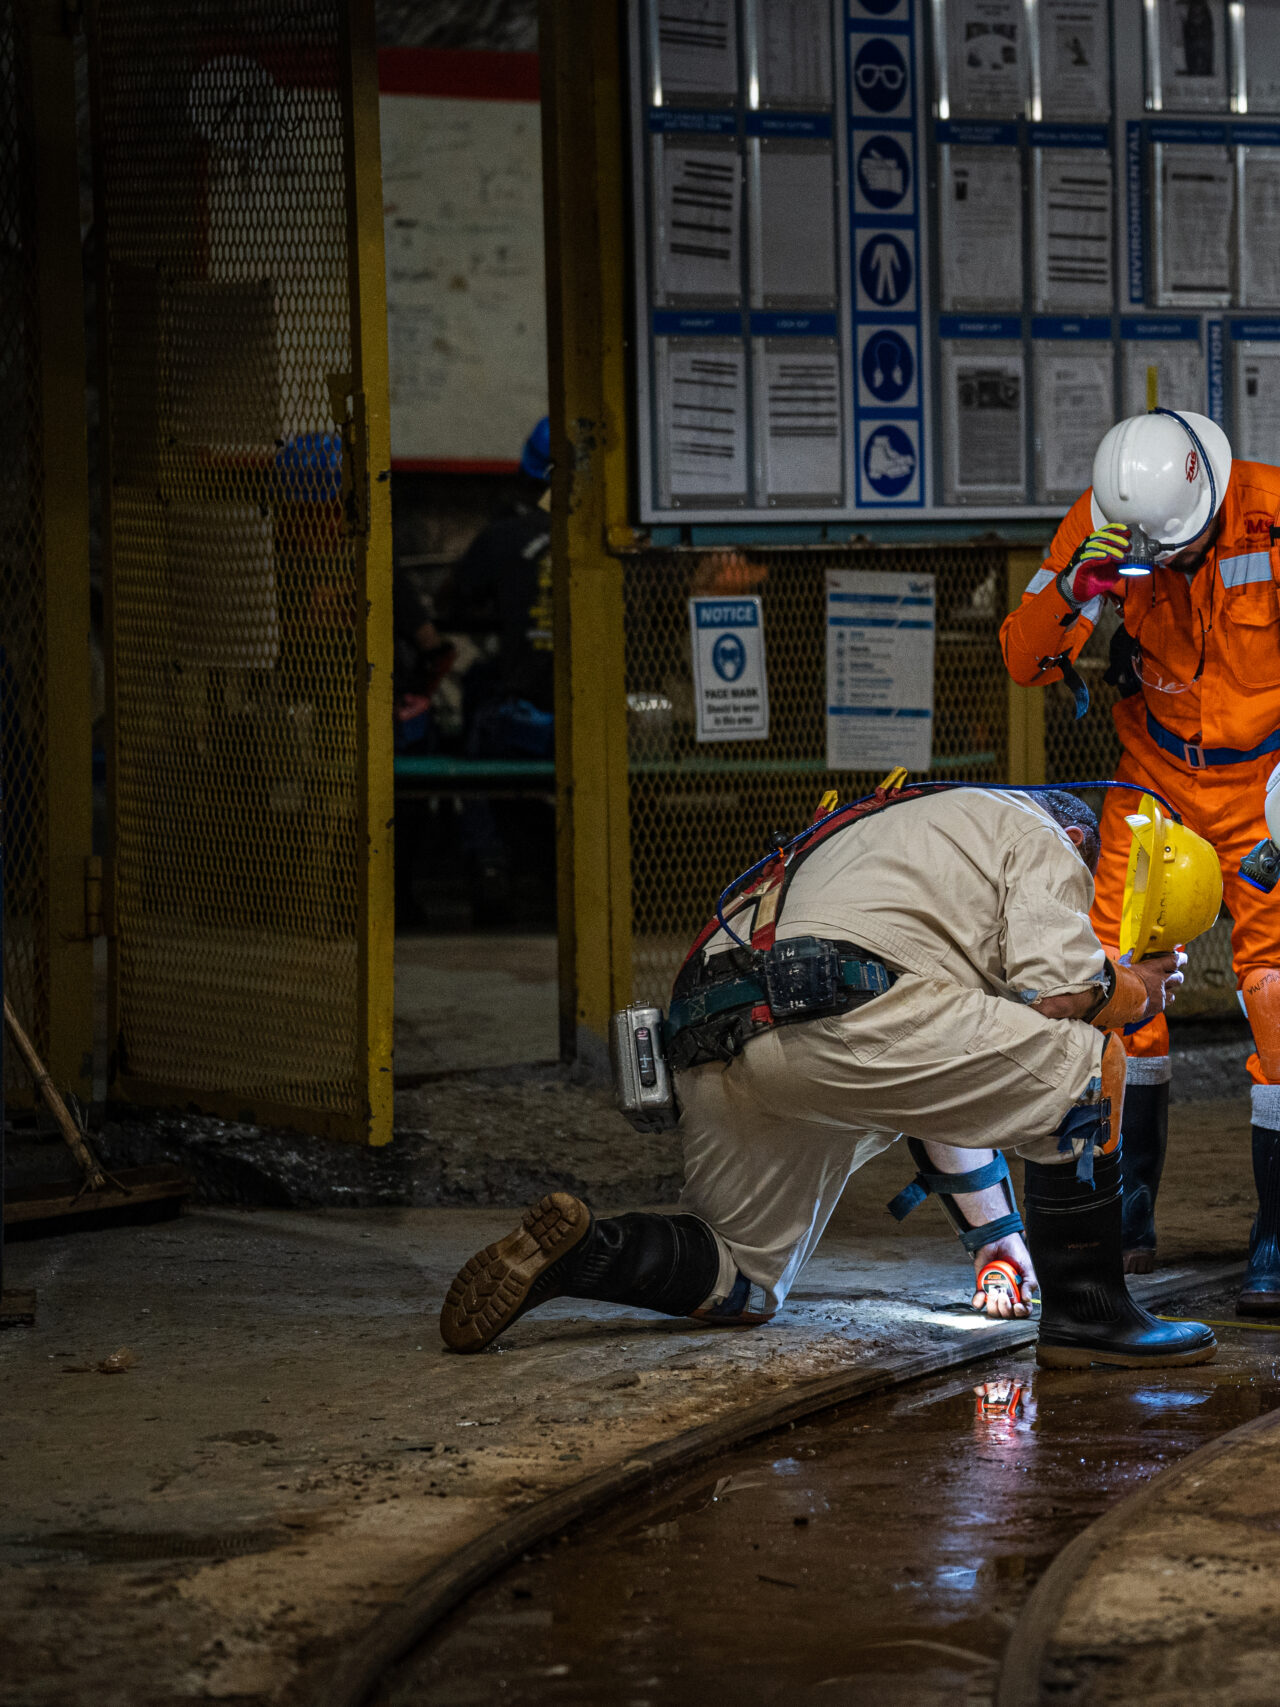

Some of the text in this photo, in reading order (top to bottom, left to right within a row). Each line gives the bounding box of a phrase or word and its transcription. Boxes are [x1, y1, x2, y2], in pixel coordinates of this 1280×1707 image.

[1130, 127, 1143, 299] ENVIRONMENTAL
[700, 605, 754, 623] NOTICE
[705, 687, 758, 699] FACE MASK
